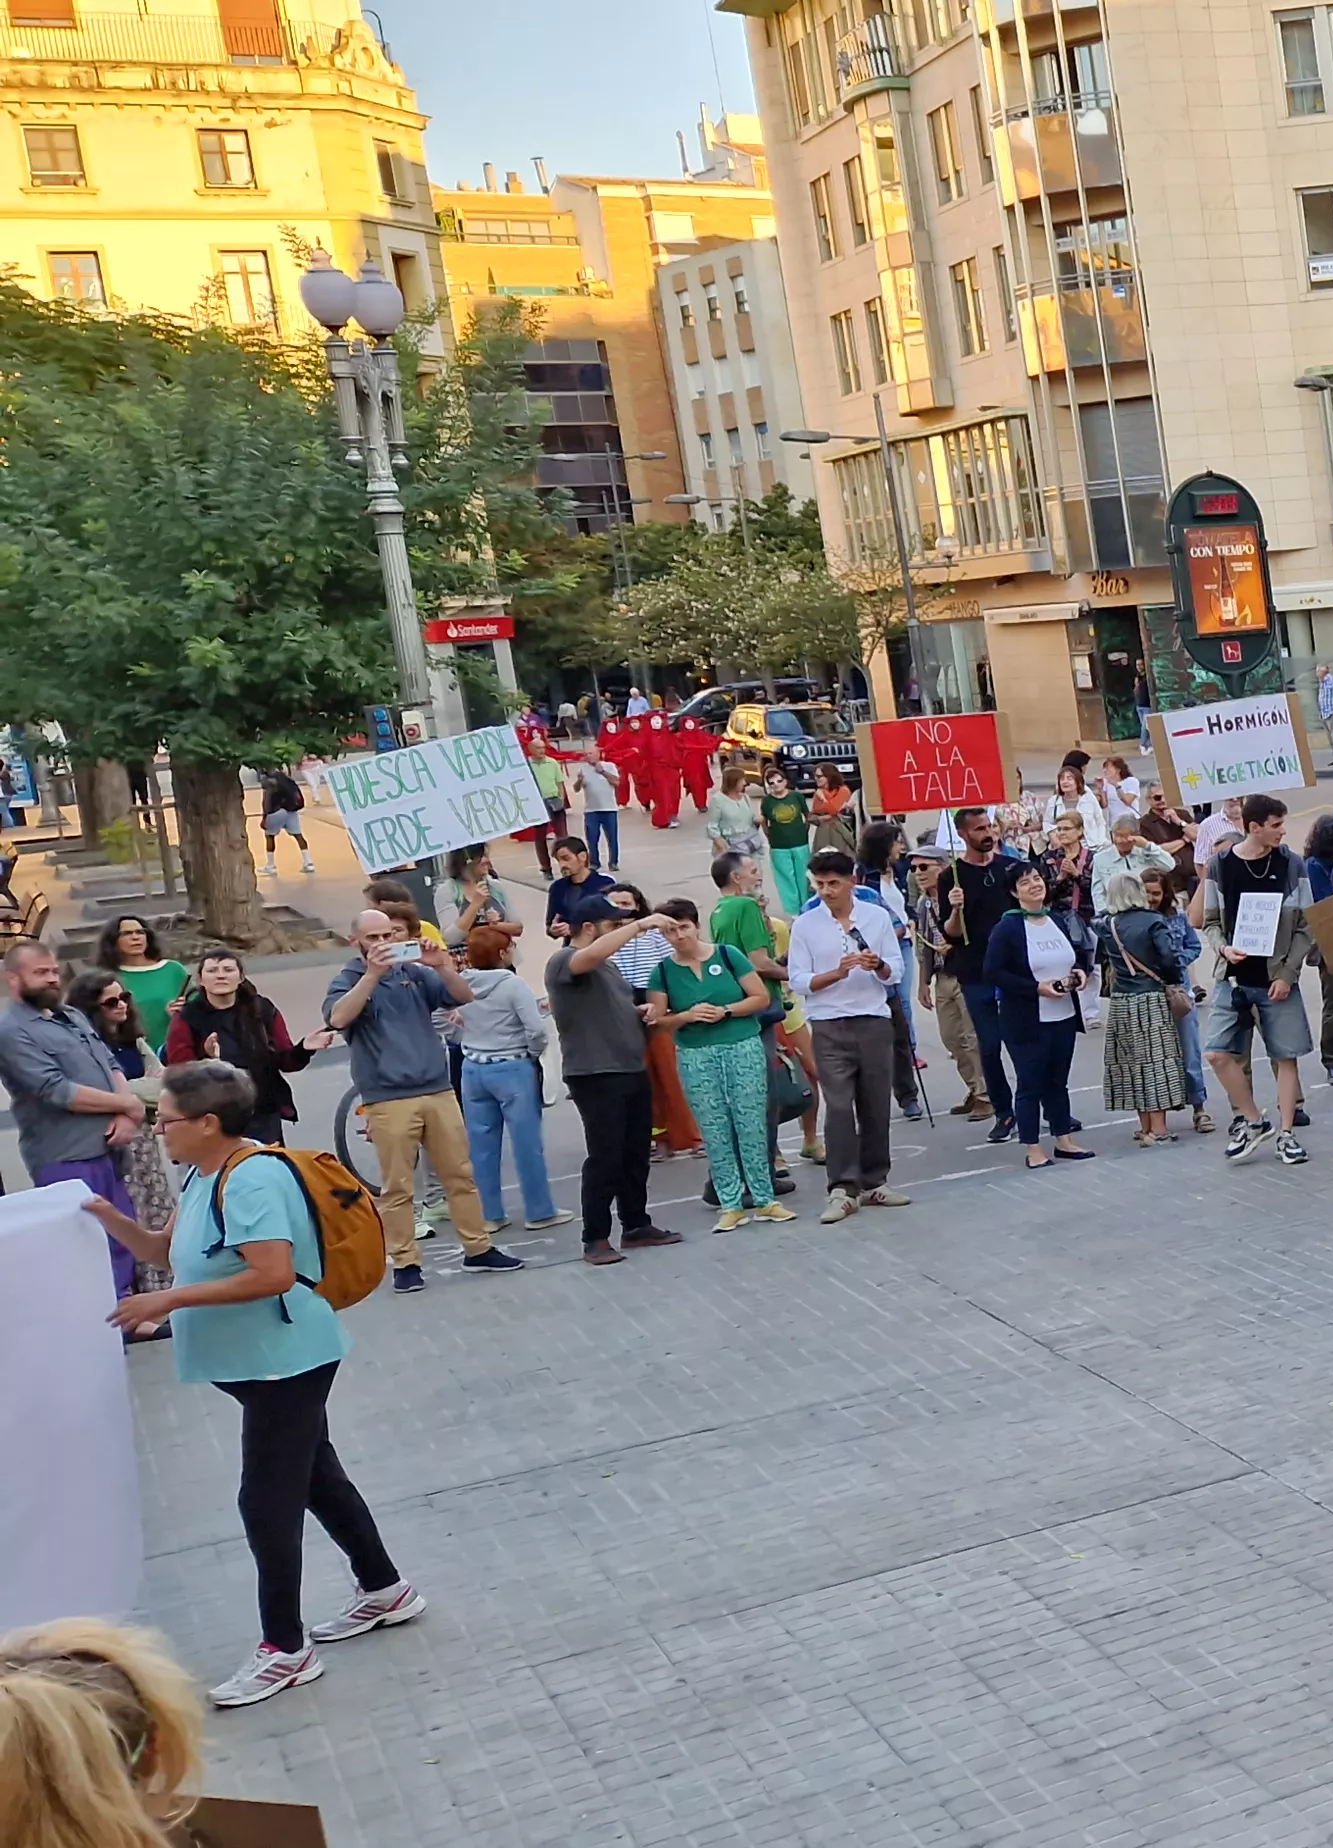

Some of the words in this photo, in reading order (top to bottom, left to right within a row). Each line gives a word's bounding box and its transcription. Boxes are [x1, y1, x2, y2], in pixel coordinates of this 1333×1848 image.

[1189, 546, 1213, 558] CON
[1214, 543, 1255, 556] TIEMPO
[1091, 570, 1129, 597] Bar
[457, 622, 499, 637] Santander
[914, 719, 952, 744] NO
[1206, 704, 1289, 735] HORMIGÓN
[328, 748, 437, 815] HUESCA
[436, 724, 527, 782] VERDE
[904, 750, 918, 772] A
[935, 745, 965, 767] LA
[1200, 748, 1299, 786] VEGETACIÓN
[898, 767, 984, 802] TALA
[446, 778, 541, 839] VERDE
